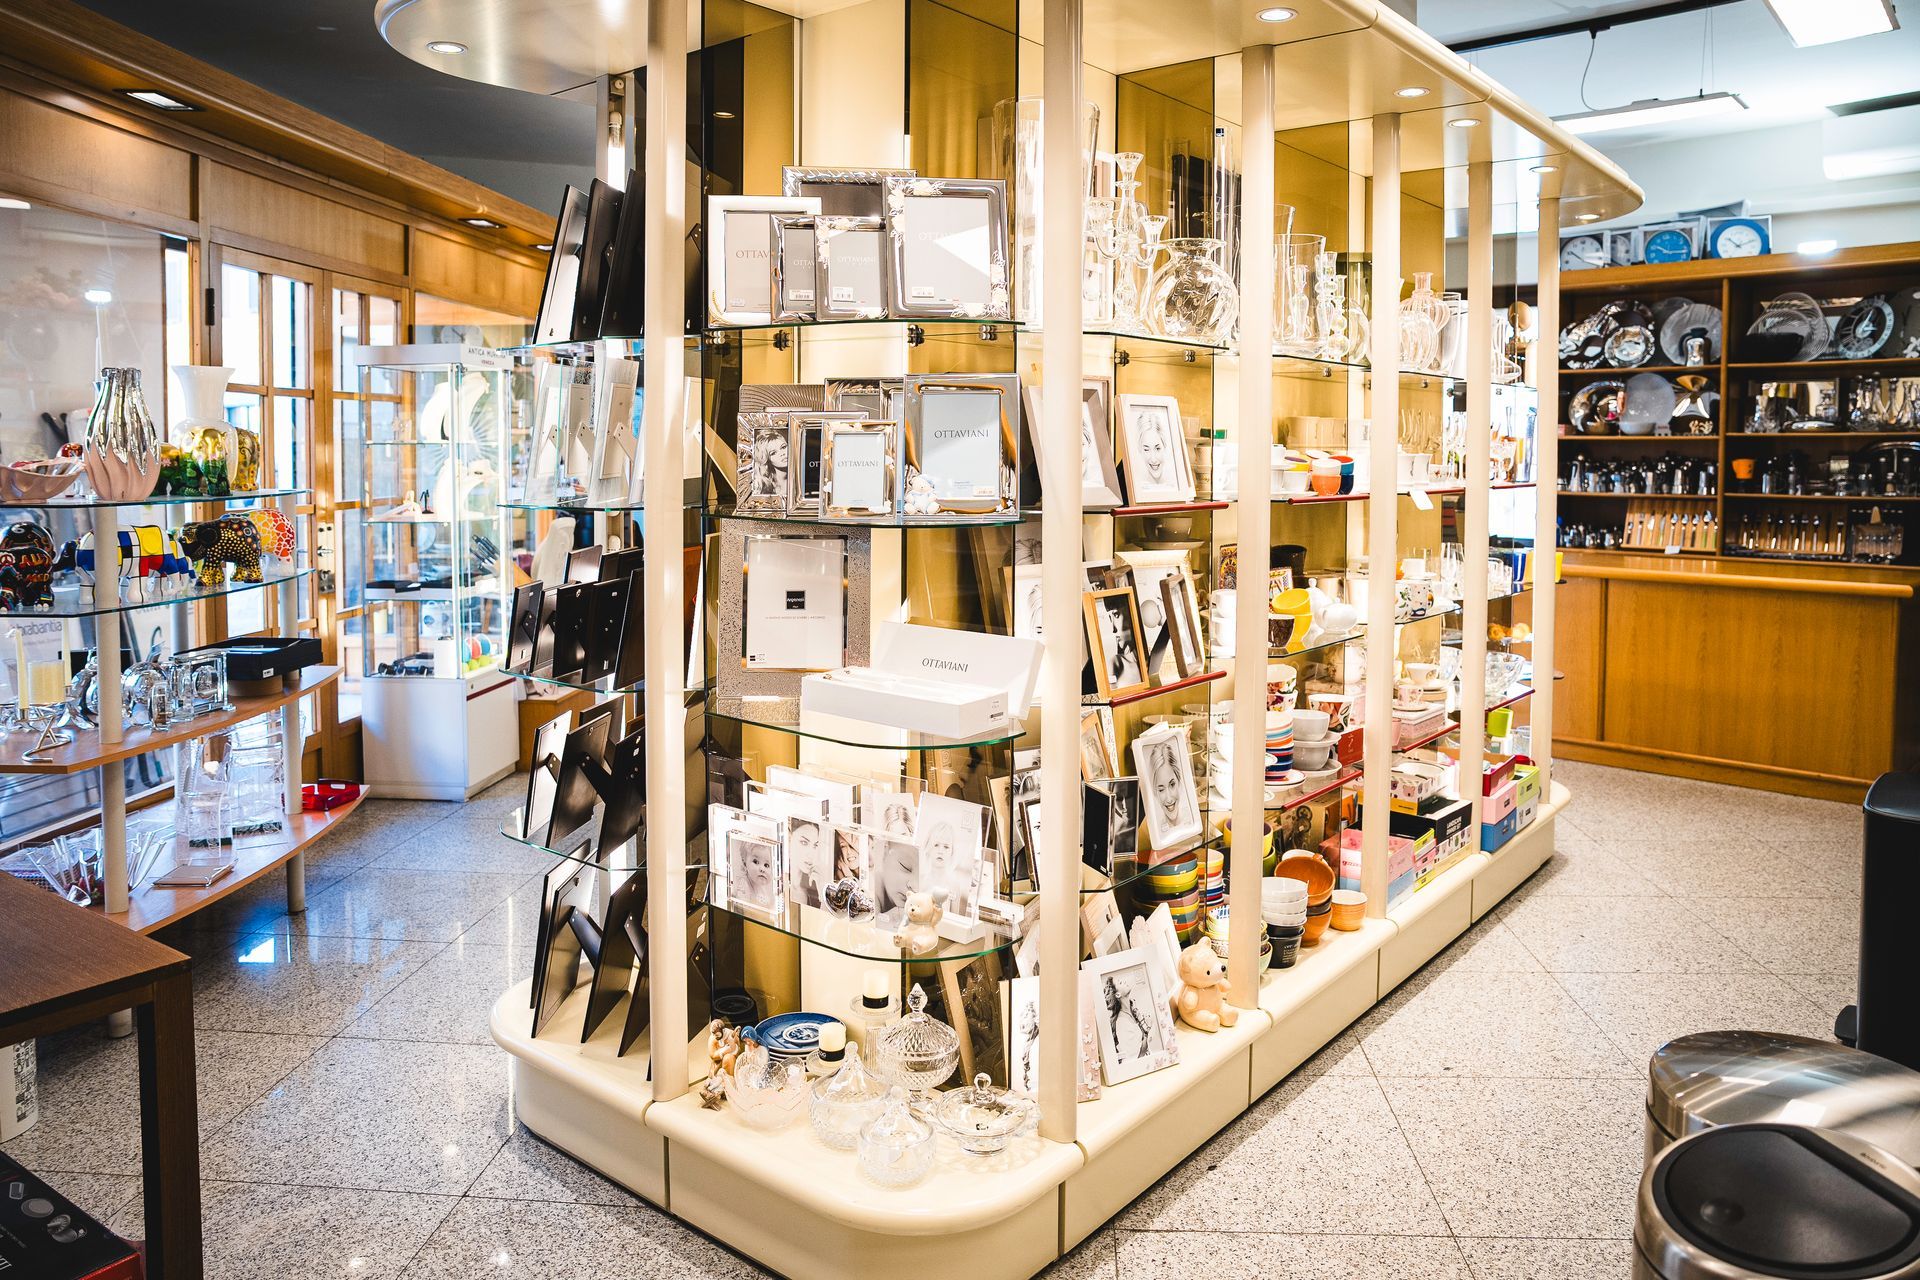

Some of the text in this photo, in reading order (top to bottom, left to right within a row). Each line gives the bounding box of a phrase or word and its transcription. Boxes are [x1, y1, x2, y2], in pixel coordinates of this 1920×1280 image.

[836, 256, 876, 265] OTTAVIANI
[468, 348, 485, 356] ANTICA
[934, 428, 989, 439] OTTAVIANI
[837, 459, 879, 468] OTTAVIANI
[16, 620, 62, 636] brabantia
[921, 657, 969, 673] OTTAVIANI
